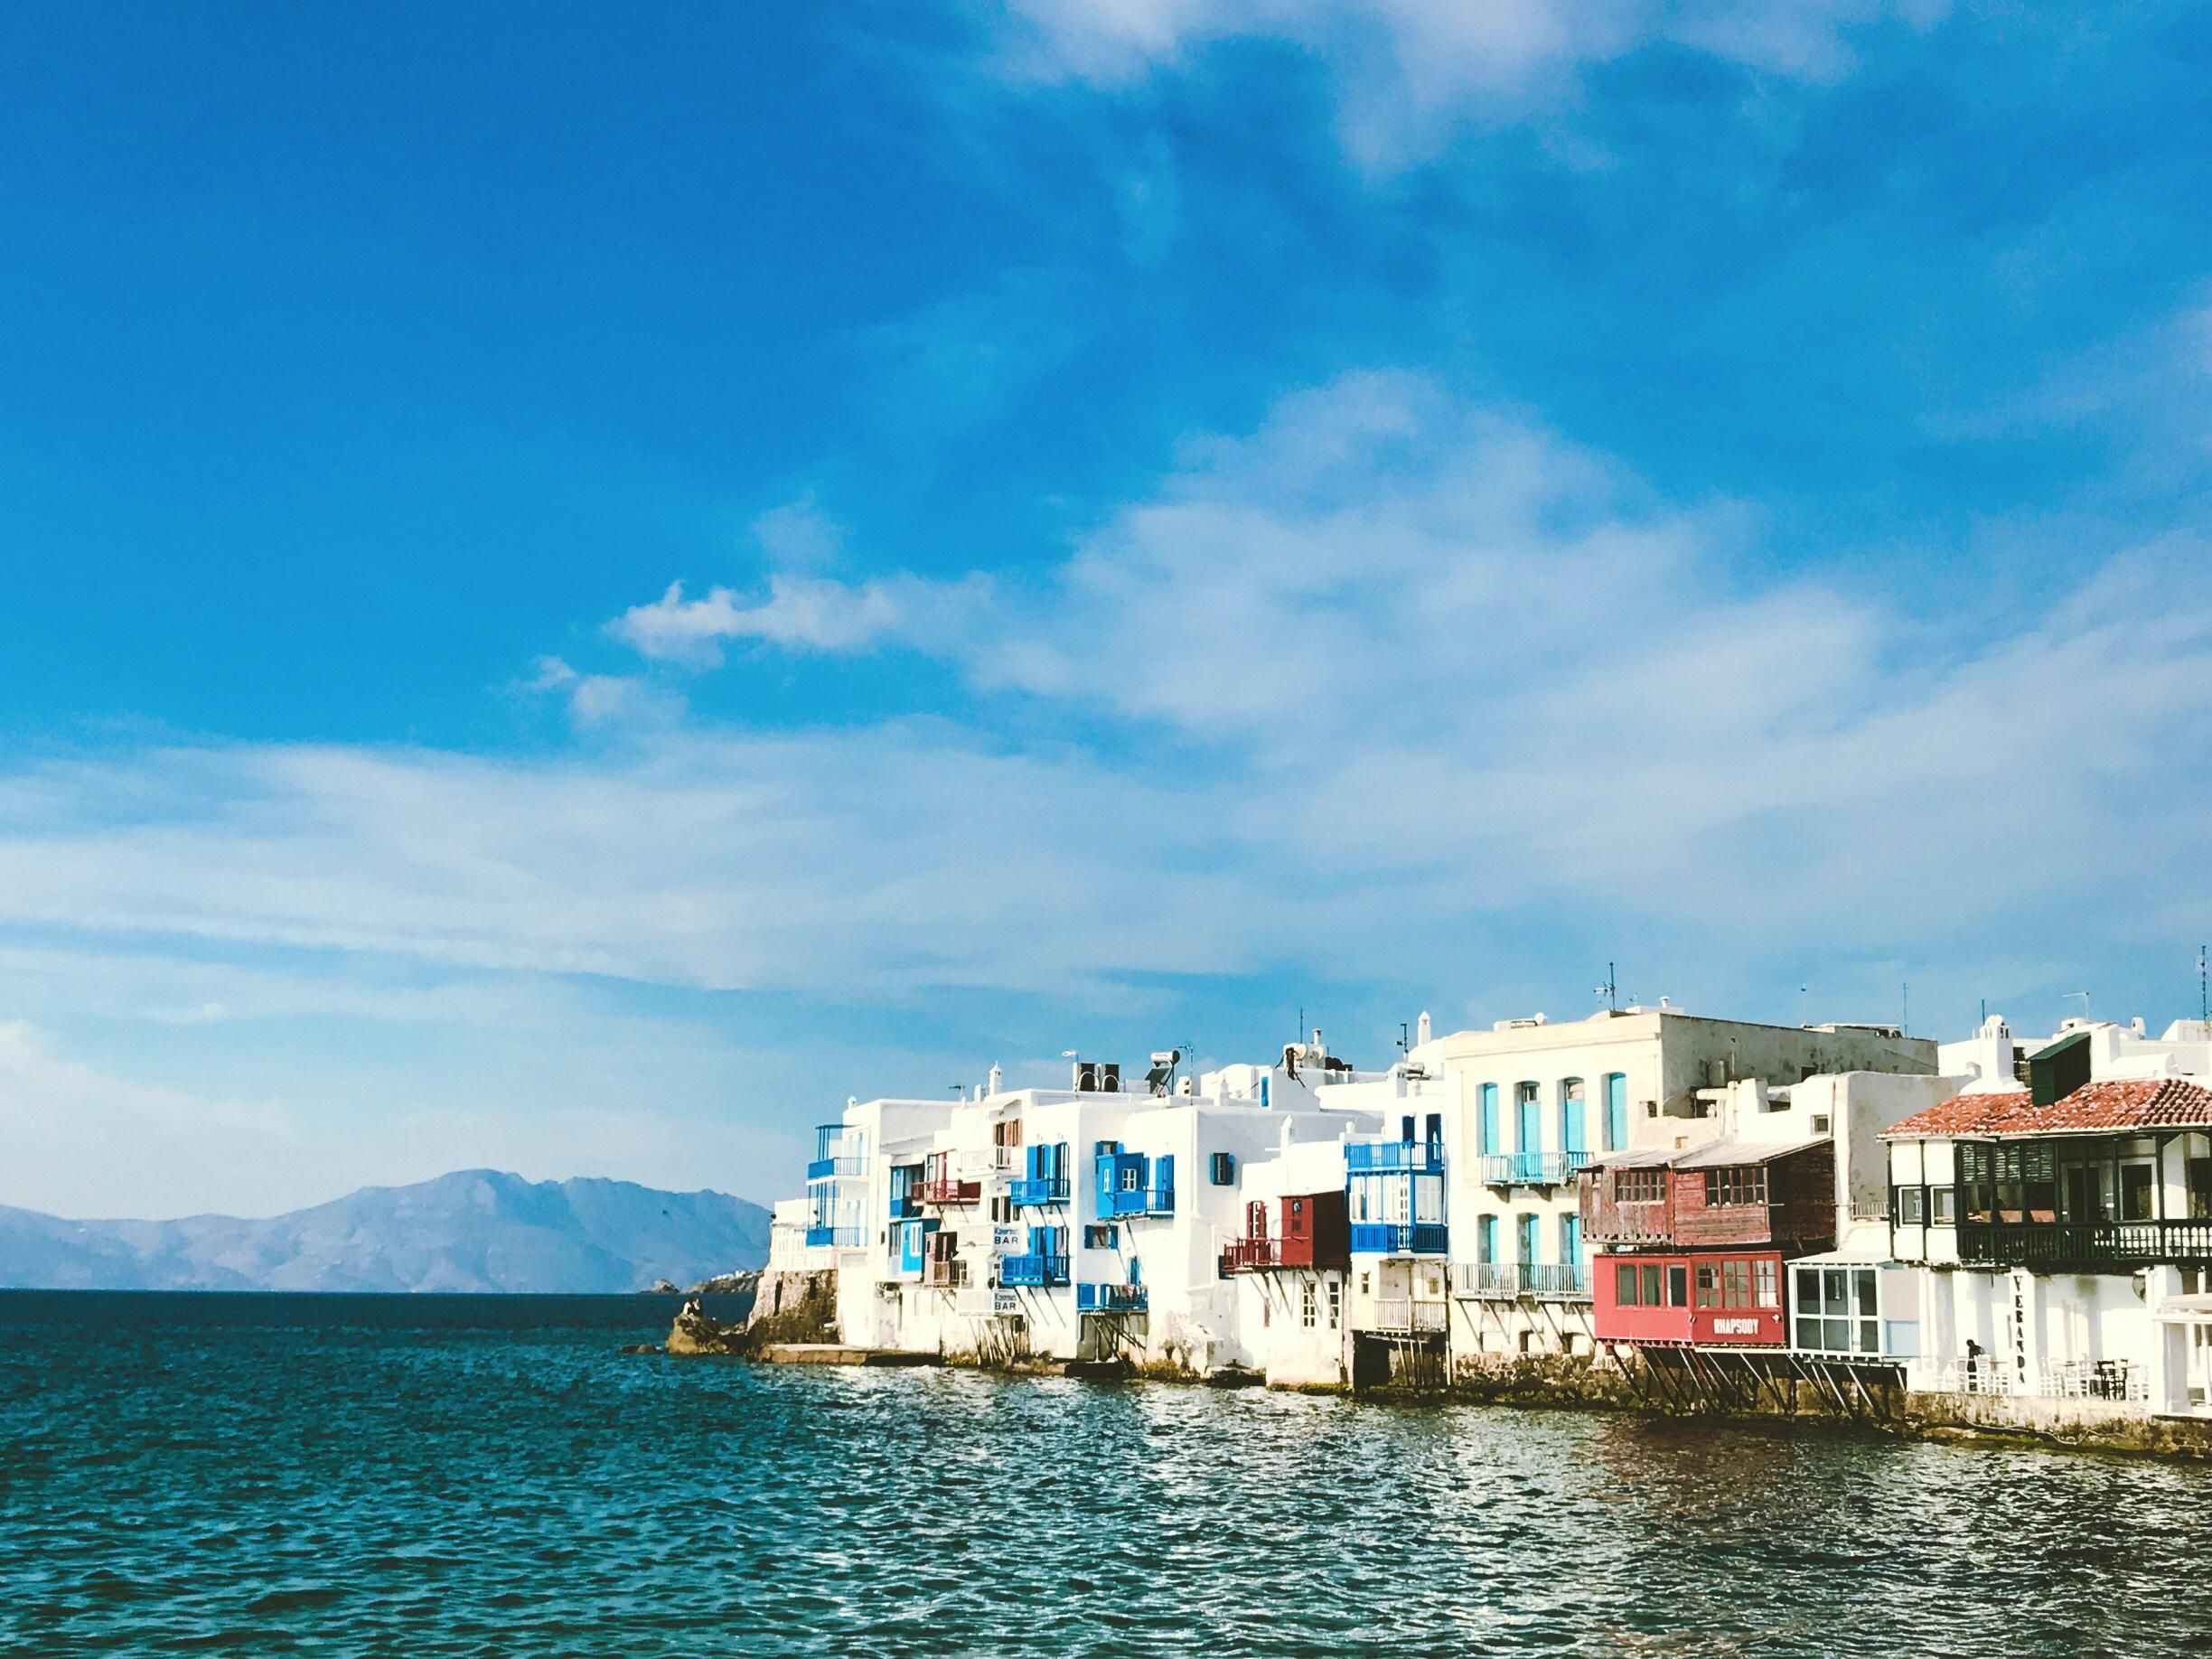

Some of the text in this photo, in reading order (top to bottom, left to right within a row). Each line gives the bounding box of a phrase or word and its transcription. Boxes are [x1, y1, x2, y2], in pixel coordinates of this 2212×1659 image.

[994, 1236, 1019, 1244] BAR
[994, 1301, 1017, 1310] BAR
[1713, 1318, 1759, 1335] RHAPSODY
[2013, 1275, 2025, 1384] VERANDA
